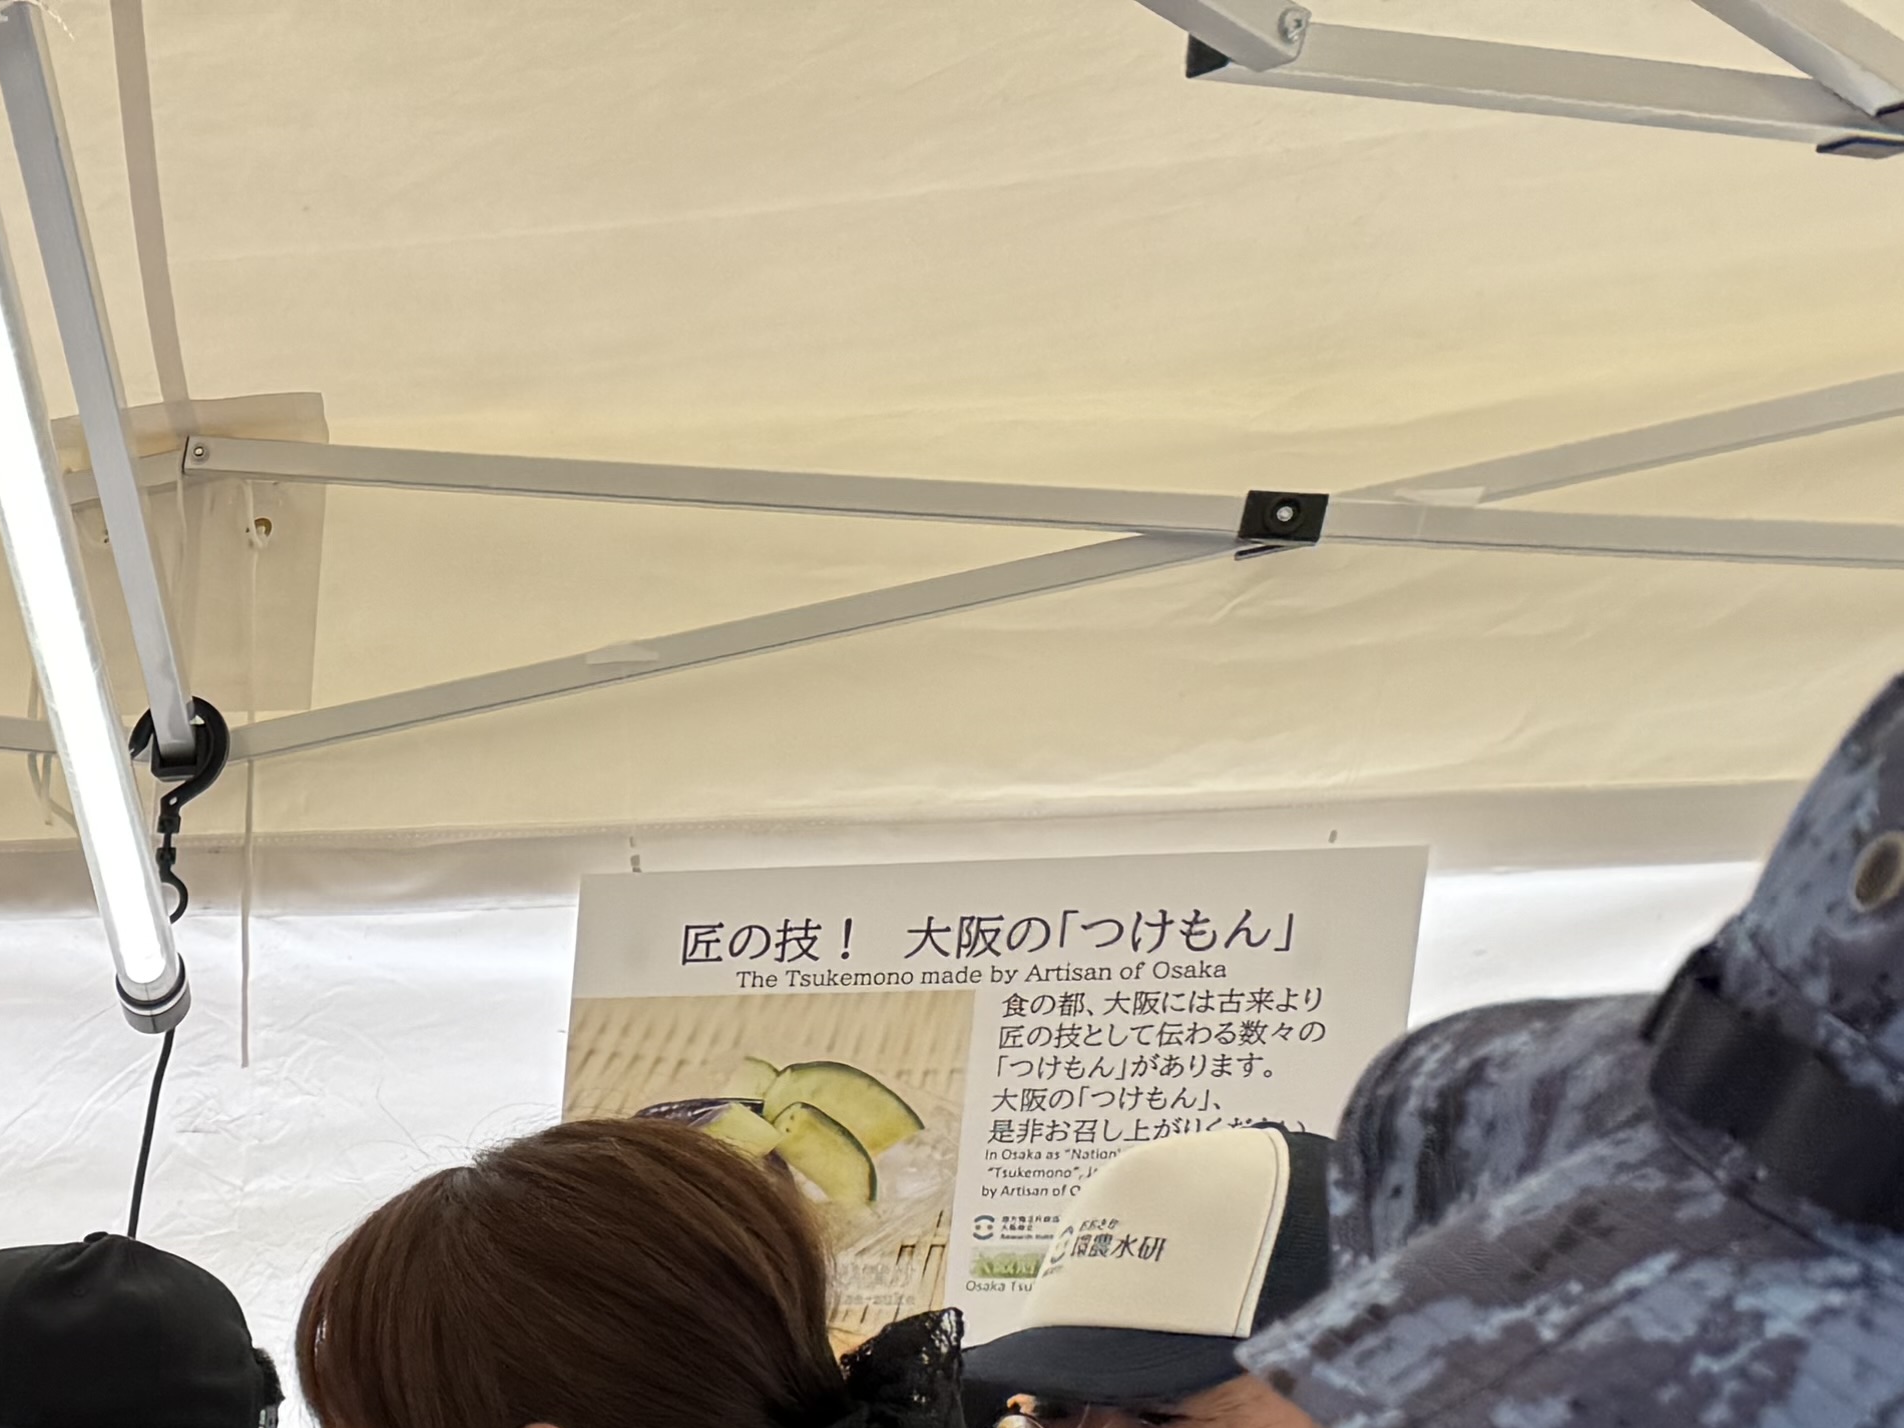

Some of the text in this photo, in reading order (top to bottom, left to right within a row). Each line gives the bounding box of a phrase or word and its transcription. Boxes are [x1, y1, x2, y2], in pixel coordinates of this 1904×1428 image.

[681, 908, 1294, 966] 匠の技！ 大阪の「つけもん」
[736, 959, 1227, 989] The Tsukemono made by Artisan of Osaka
[1001, 986, 1323, 1019] 食の都、大阪には古来より
[998, 1020, 1327, 1050] 匠の技として伝わる数々の
[995, 1051, 1274, 1081] 「つけもん」があります。
[990, 1085, 1222, 1113] 大阪の「つけもん」、
[986, 1117, 1306, 1145] 是非お召し上がり
[985, 1149, 993, 1161] In
[1001, 1148, 1042, 1161] Osaka
[1045, 1150, 1060, 1161] as
[981, 1185, 997, 1199] by
[1000, 1185, 1049, 1197] Artisan
[1052, 1184, 1067, 1197] of
[965, 1280, 1033, 1292] Osaka Tsu
